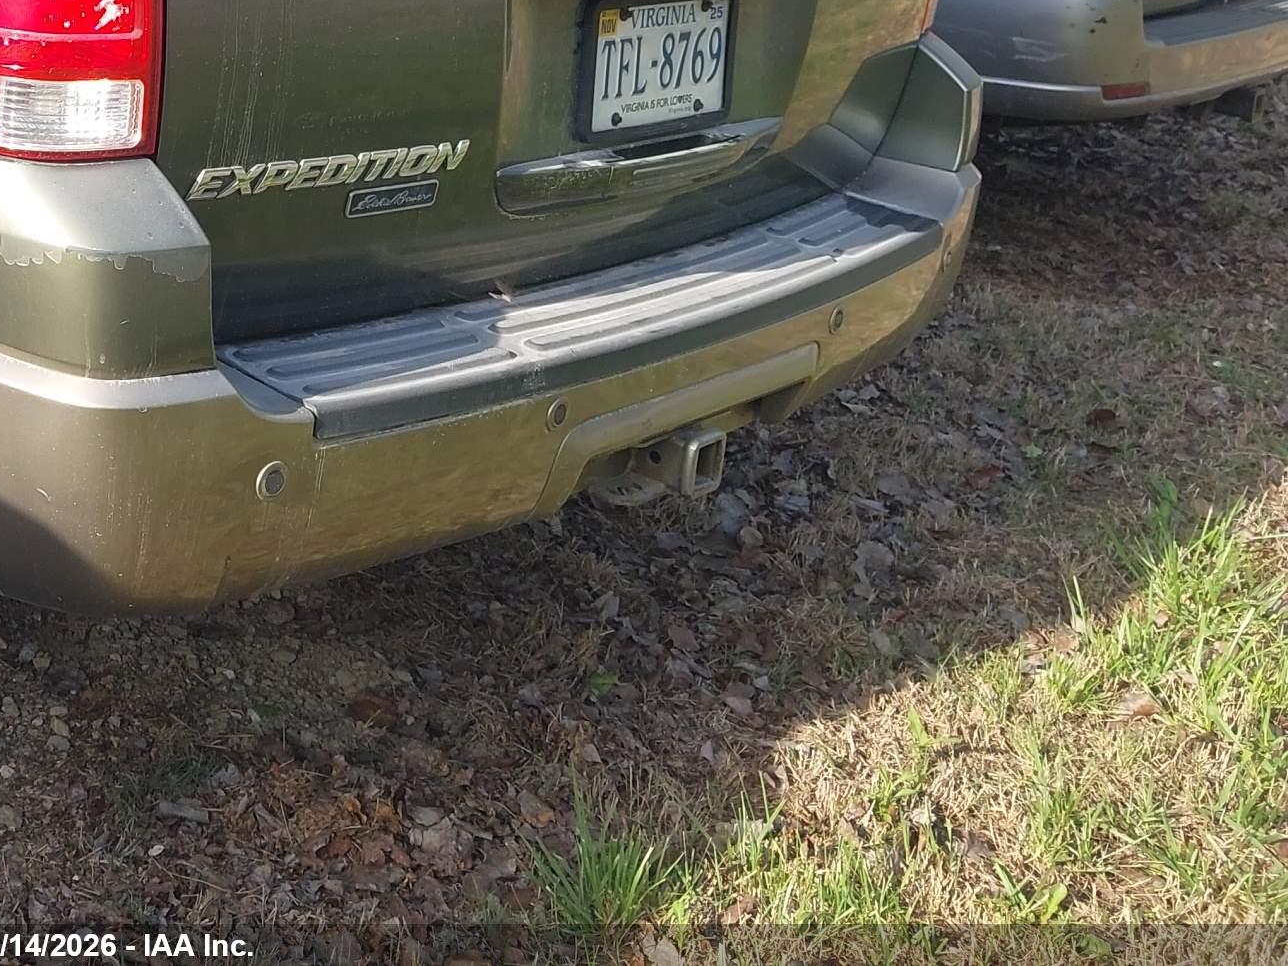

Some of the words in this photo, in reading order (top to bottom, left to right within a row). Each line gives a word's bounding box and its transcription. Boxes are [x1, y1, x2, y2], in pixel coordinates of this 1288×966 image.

[631, 4, 697, 29] VIRGINIA
[710, 6, 724, 20] 25
[601, 27, 723, 100] TFL-8769
[621, 100, 649, 114] VIRGINIA
[656, 97, 669, 108] FOR
[185, 139, 471, 201] EXPEDITION
